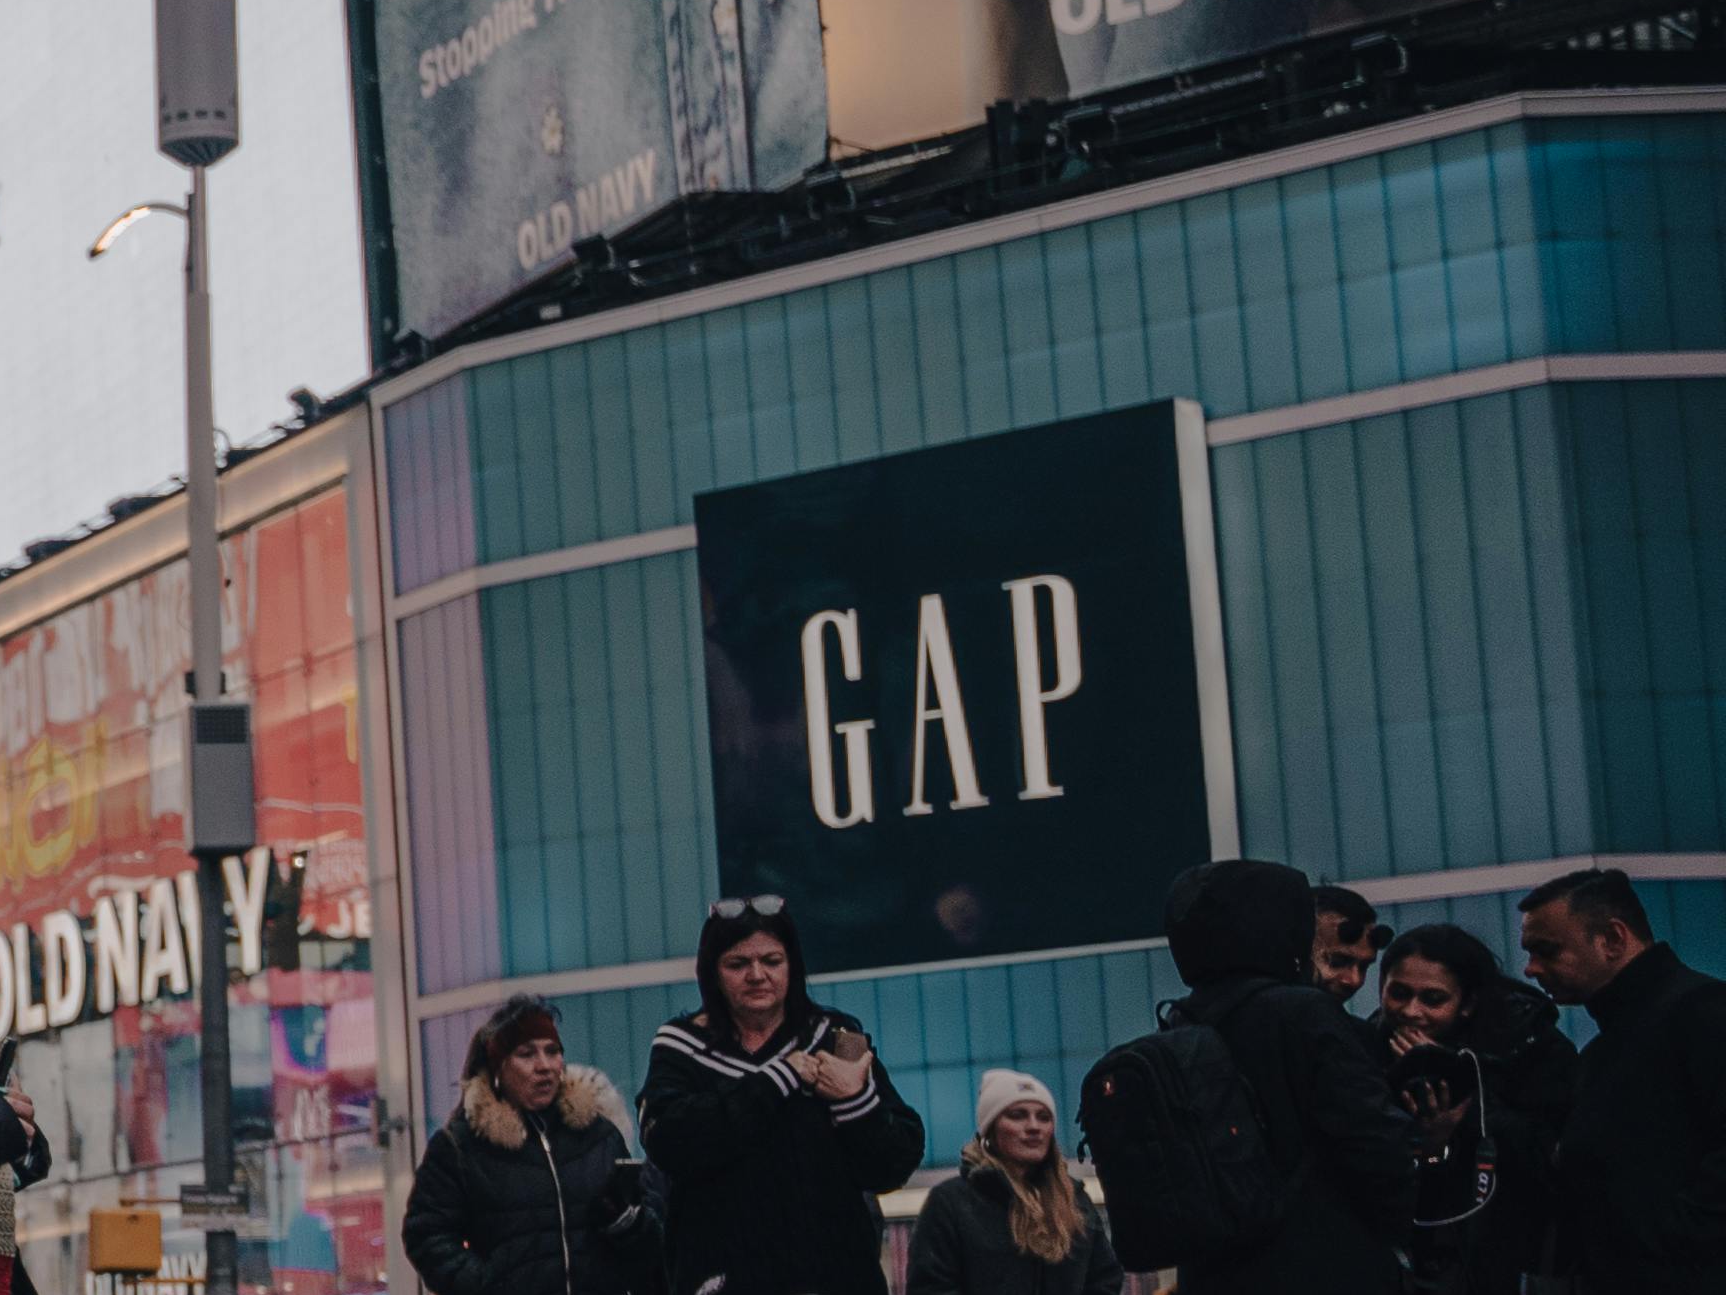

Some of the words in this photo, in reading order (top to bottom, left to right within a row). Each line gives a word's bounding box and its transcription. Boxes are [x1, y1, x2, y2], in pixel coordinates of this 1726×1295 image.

[517, 199, 573, 272] OLD
[575, 148, 657, 235] NAVY
[800, 573, 1084, 830] GAP
